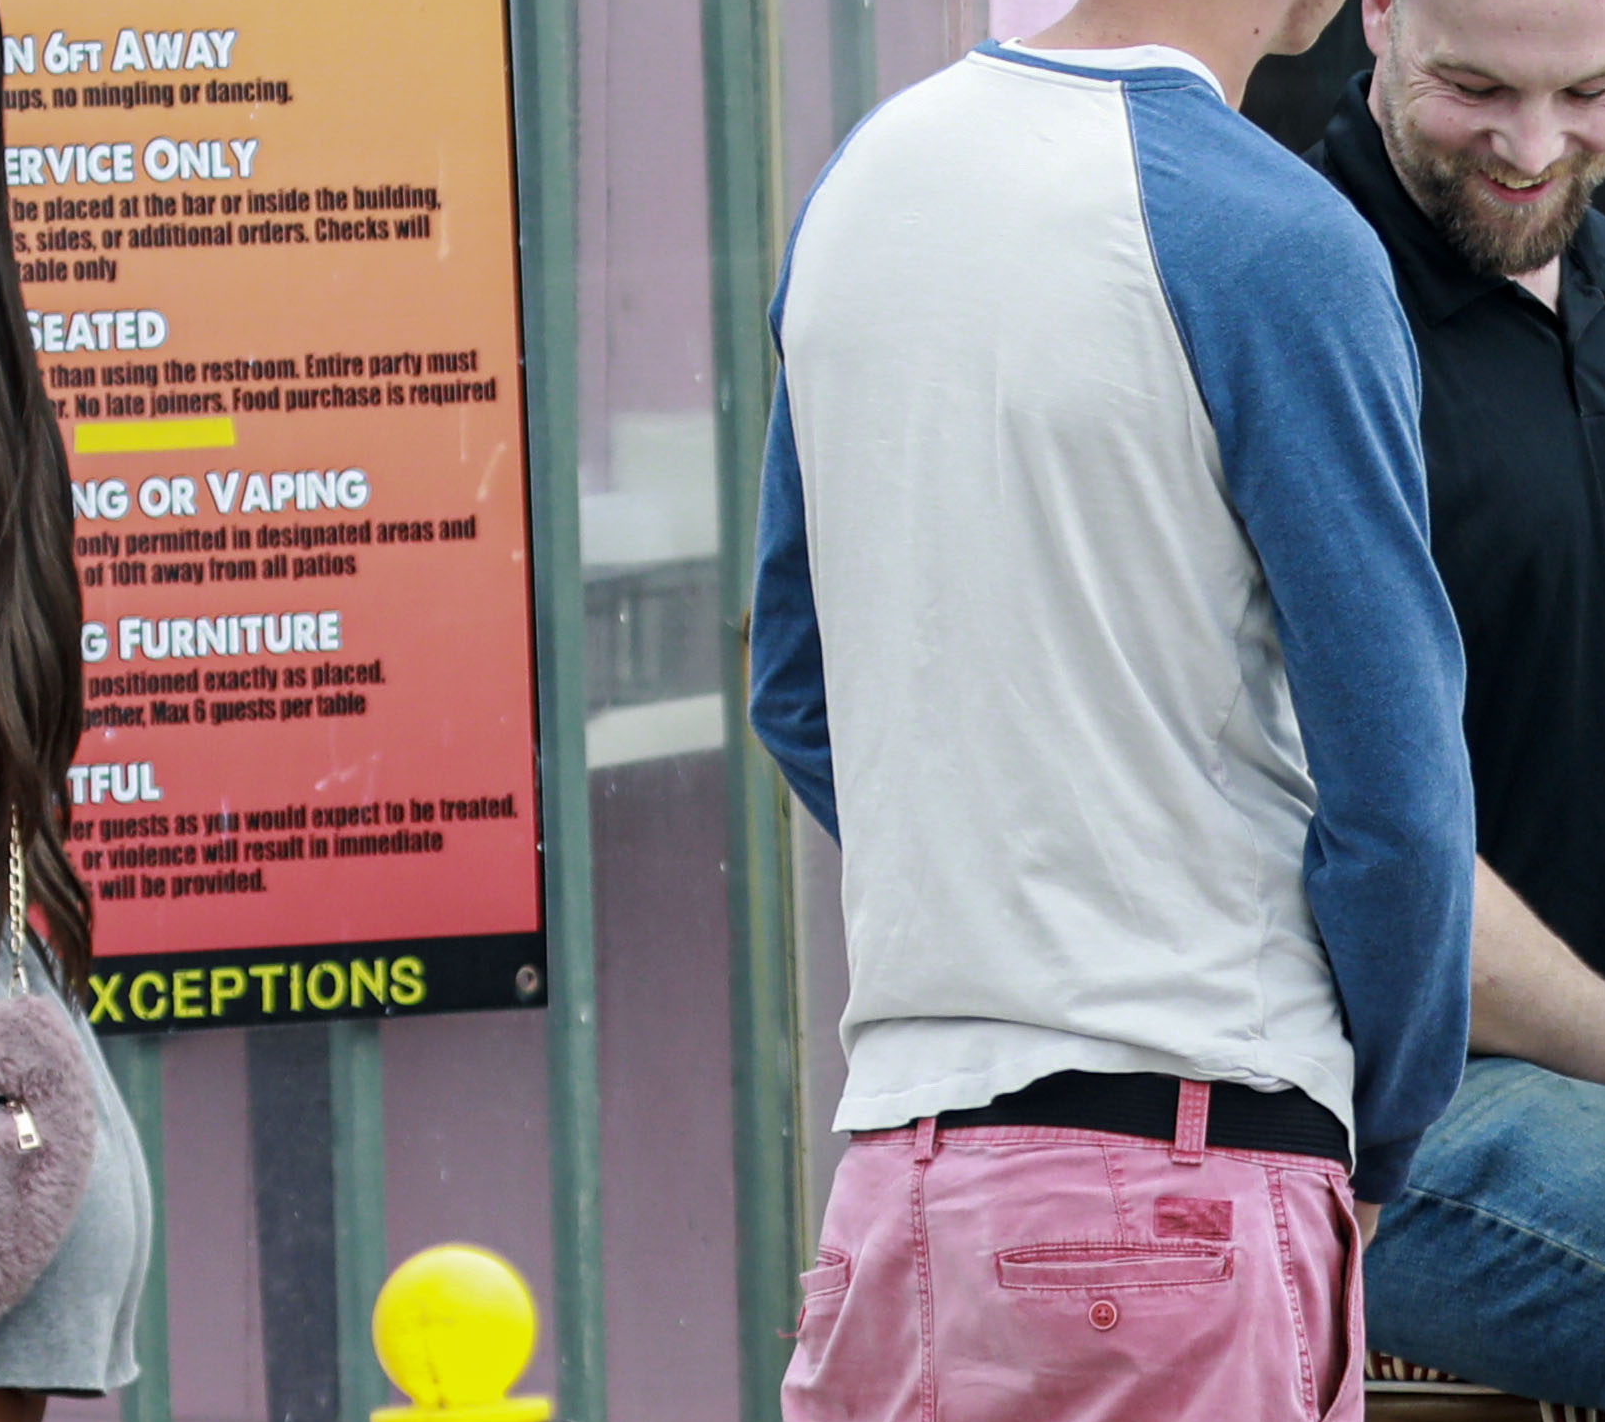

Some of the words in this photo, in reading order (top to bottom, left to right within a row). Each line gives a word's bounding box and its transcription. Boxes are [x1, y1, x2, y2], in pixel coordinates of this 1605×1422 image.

[53, 87, 77, 108] no
[83, 81, 174, 109] mingling
[180, 83, 201, 104] or
[206, 78, 292, 105] dancing.
[5, 142, 135, 186] ERVICE
[143, 136, 258, 182] ONLY
[12, 197, 37, 221] be
[44, 195, 113, 222] placed
[119, 196, 138, 218] at
[145, 193, 177, 217] the
[182, 192, 216, 216] bar
[221, 194, 241, 215] or
[248, 189, 309, 213] inside
[316, 187, 347, 211] the
[36, 227, 97, 252] sides,
[102, 229, 122, 249] or
[128, 222, 232, 248] additional
[238, 221, 309, 245] orders.
[315, 216, 389, 241] Checks
[395, 214, 430, 240] will
[73, 255, 117, 282] only
[50, 364, 94, 388] than
[101, 361, 158, 387] using
[163, 359, 195, 383] the
[202, 357, 300, 381] restroom.
[306, 352, 363, 378] Entire
[369, 353, 421, 378] party
[427, 349, 478, 373] must
[74, 394, 100, 418] No
[106, 393, 144, 417] late
[150, 390, 227, 418] joiners.
[233, 387, 279, 412] Food
[286, 384, 381, 413] purchase
[387, 382, 404, 405] is
[410, 377, 496, 406] required
[75, 532, 119, 556] only
[125, 527, 225, 555] permitted
[233, 526, 250, 548] in
[256, 521, 371, 550] designated
[377, 520, 433, 543] areas
[439, 515, 476, 540] and
[84, 564, 103, 587] of
[109, 562, 146, 586] 10ft
[151, 562, 204, 585] away
[210, 557, 256, 580] from
[262, 555, 287, 578] all
[293, 555, 356, 580] patios
[89, 670, 198, 699] positioned
[204, 666, 277, 691] exactly
[284, 666, 305, 686] as
[312, 659, 385, 687] placed.
[82, 703, 146, 730] gether,
[151, 701, 189, 725] Max
[194, 699, 205, 723] 6
[212, 696, 276, 725] guests
[281, 697, 312, 721] per
[317, 692, 365, 717] table
[99, 814, 169, 841] guests
[174, 815, 198, 836] as
[203, 811, 239, 836] you
[245, 803, 306, 830] would
[312, 802, 380, 831] expect
[386, 801, 405, 824] to
[410, 798, 434, 823] be
[440, 793, 517, 821] treated.
[82, 849, 103, 871] or
[108, 843, 196, 869] violence
[203, 838, 238, 864] will
[244, 835, 303, 861] result
[309, 834, 328, 858] in
[334, 830, 443, 857] immediate
[99, 874, 135, 900] will
[141, 874, 165, 898] be
[171, 868, 266, 899] provided.
[88, 954, 426, 1024] XCEPTIONS
